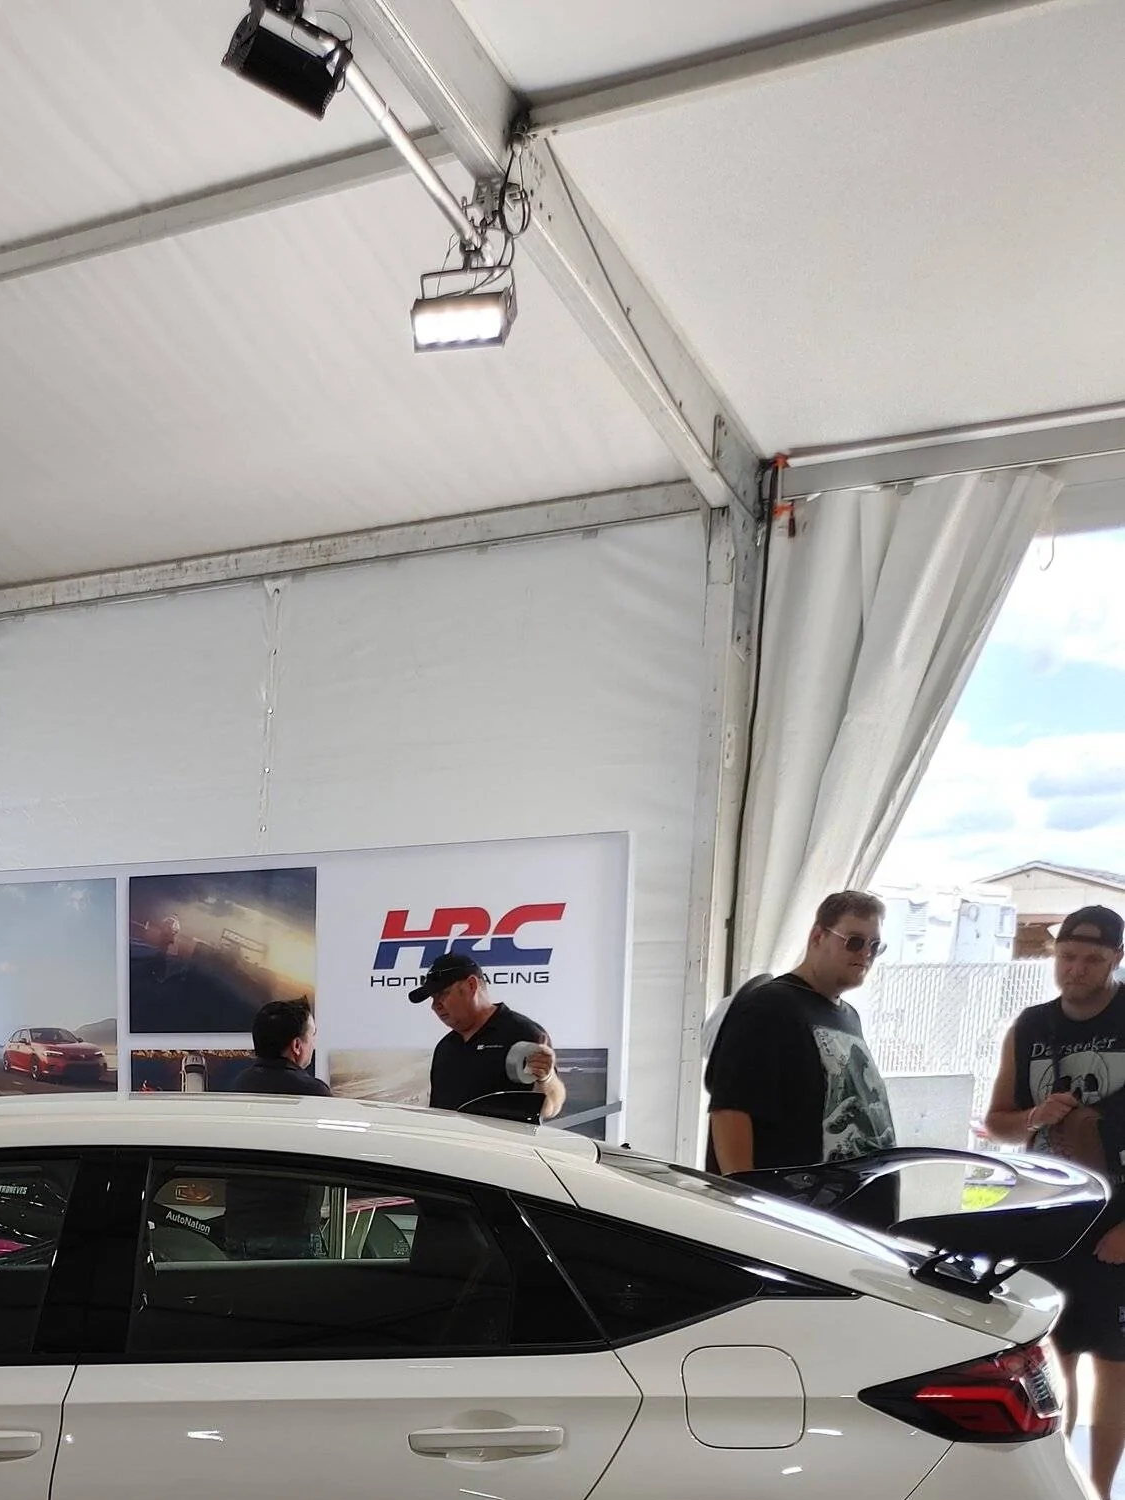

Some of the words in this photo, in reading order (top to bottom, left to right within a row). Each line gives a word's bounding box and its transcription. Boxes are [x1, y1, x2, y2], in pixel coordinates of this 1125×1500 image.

[373, 902, 566, 970] HRC
[483, 971, 550, 985] ACING
[1030, 1036, 1116, 1059] Daseeker
[165, 1210, 211, 1234] AutoNation
